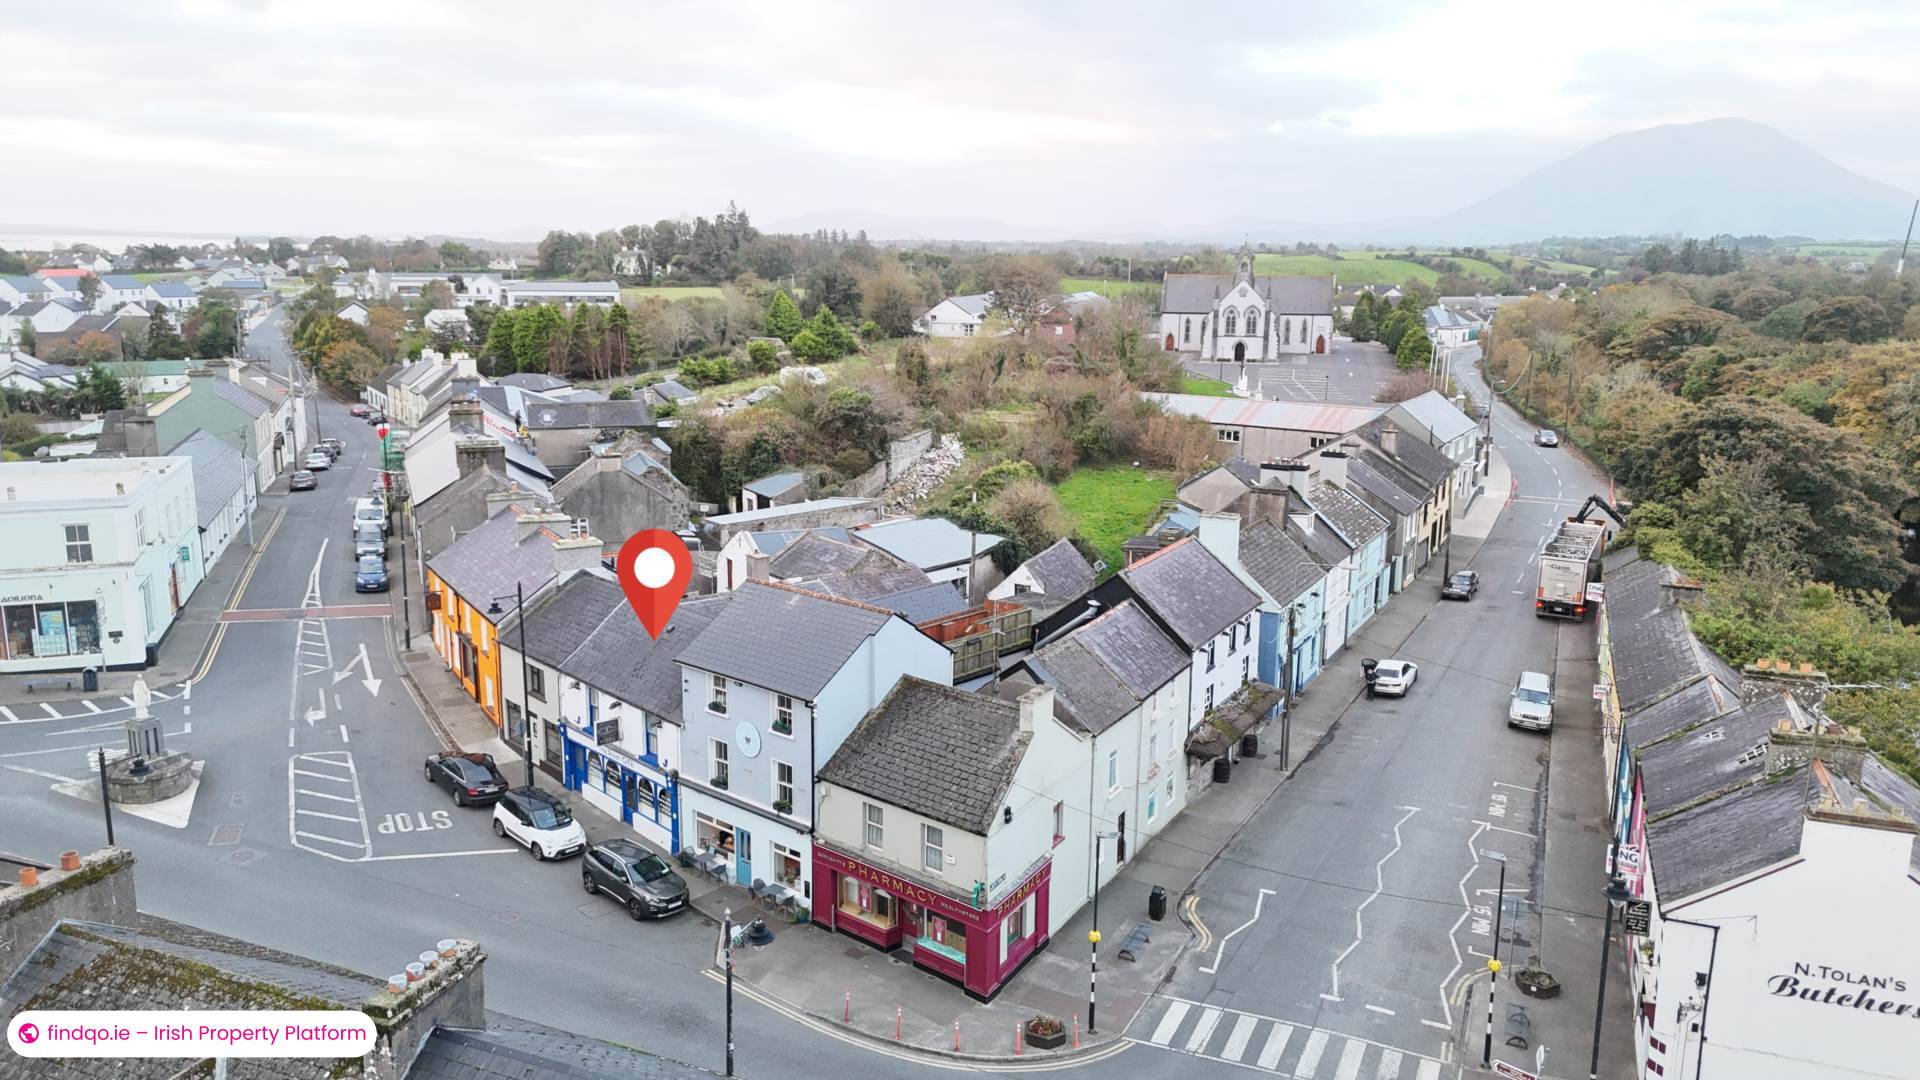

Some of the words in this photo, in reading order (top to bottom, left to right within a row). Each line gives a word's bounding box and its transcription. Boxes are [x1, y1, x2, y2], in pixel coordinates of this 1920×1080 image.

[378, 810, 453, 834] STOP
[848, 860, 937, 905] PHARMACY
[997, 868, 1048, 919] PHARMACY
[1767, 974, 1920, 1019] Butchers
